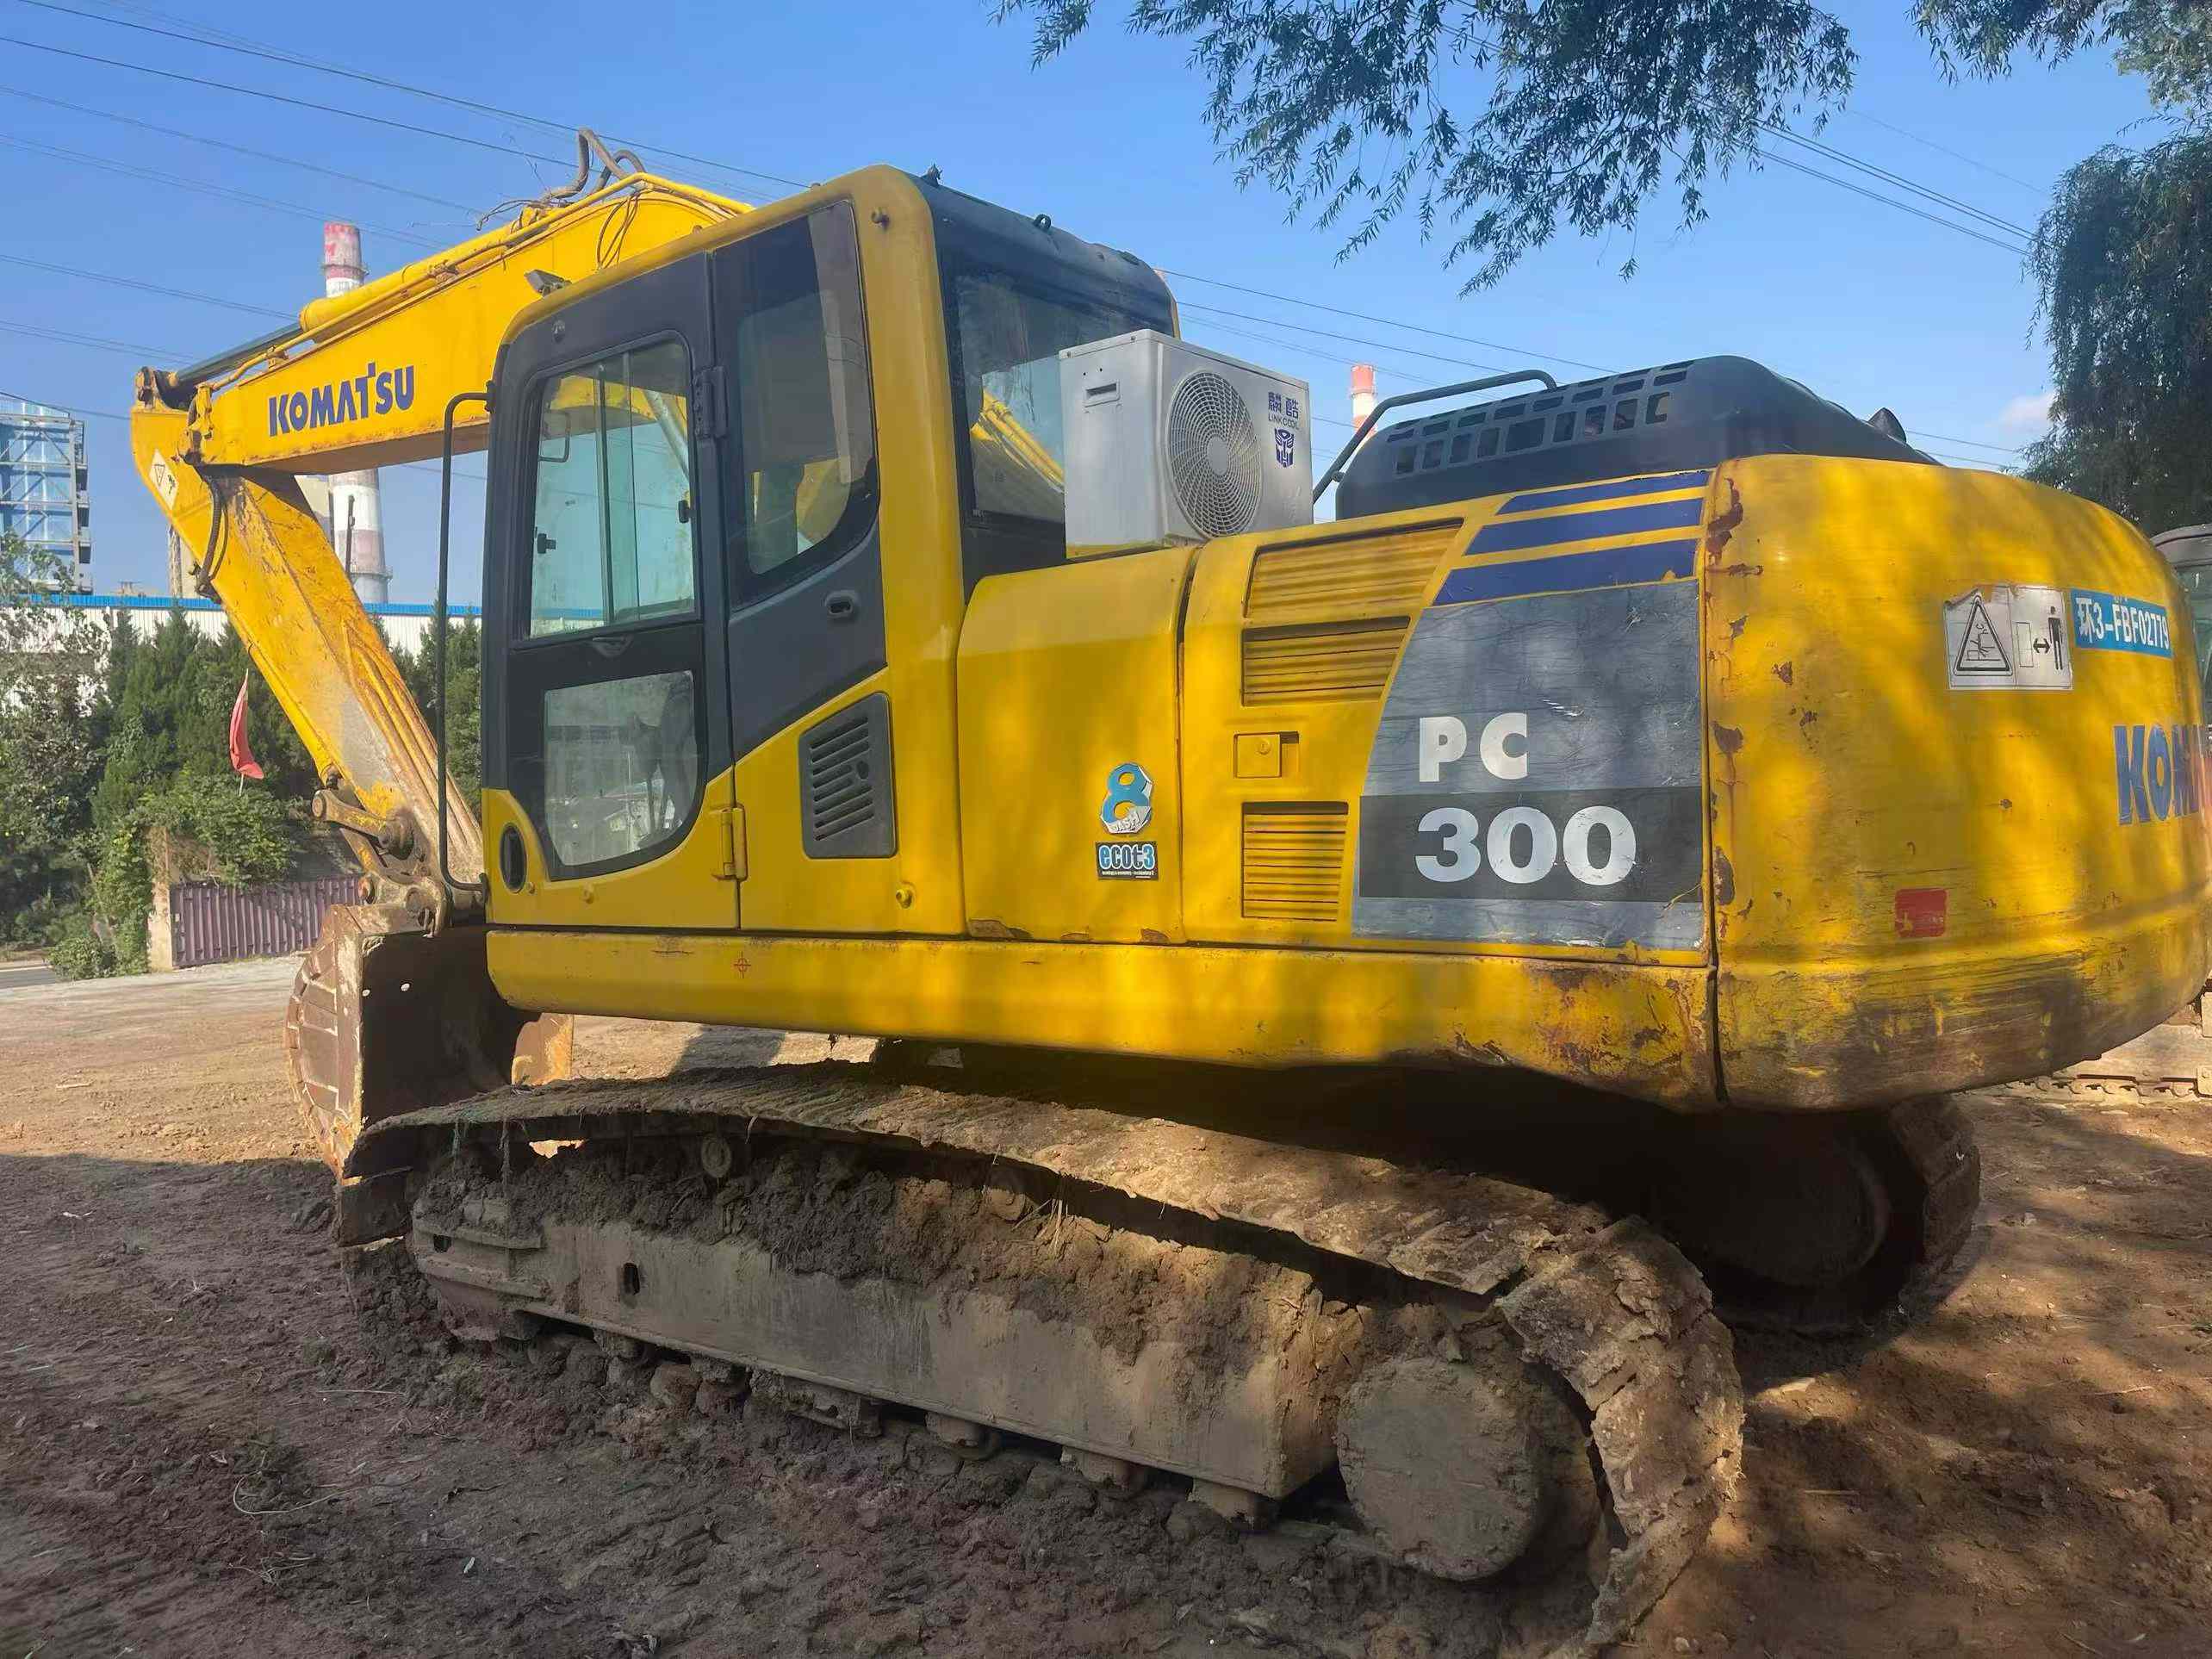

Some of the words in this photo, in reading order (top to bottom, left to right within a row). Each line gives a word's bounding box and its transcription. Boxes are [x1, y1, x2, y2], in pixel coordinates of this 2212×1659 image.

[269, 362, 414, 437] KOMATSU
[1419, 711, 1528, 782] PC
[1098, 843, 1155, 870] ecot3
[1414, 805, 1637, 885] 300
